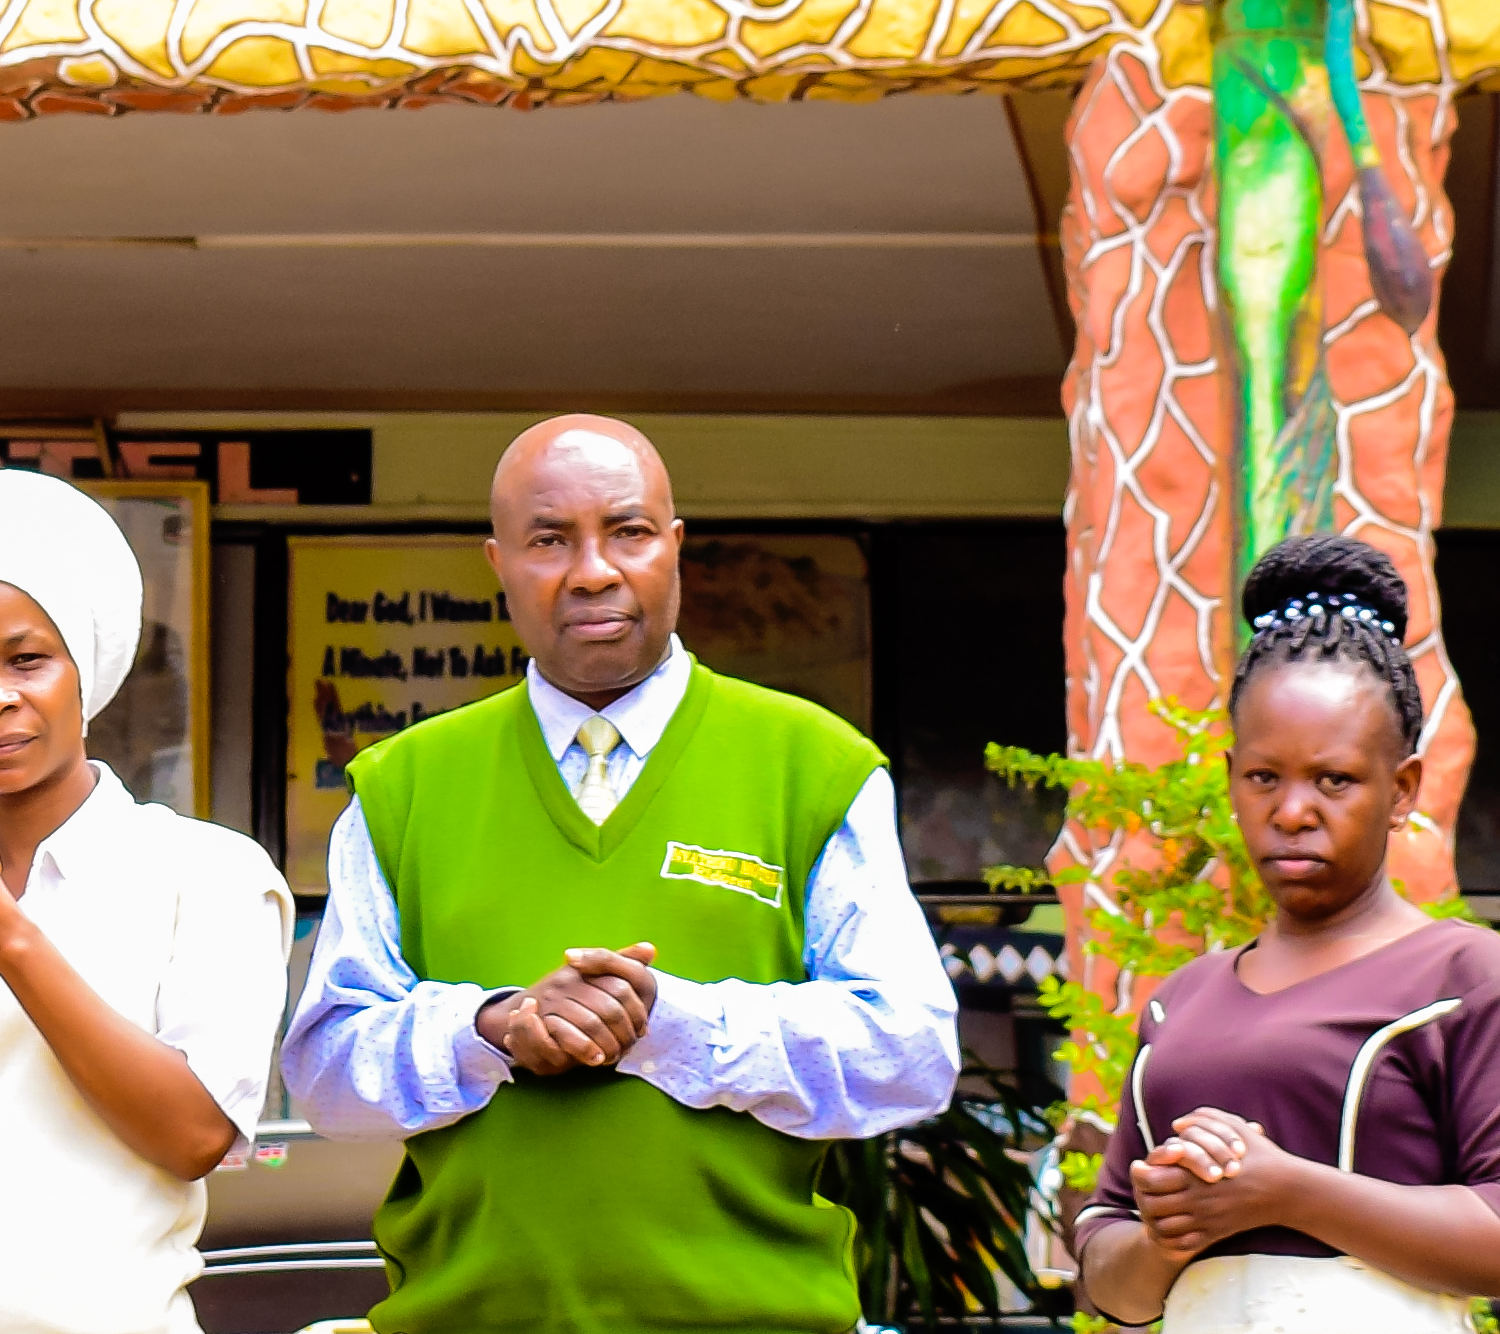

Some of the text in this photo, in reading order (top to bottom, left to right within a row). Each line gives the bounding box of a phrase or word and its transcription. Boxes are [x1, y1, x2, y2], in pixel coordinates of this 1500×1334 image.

[326, 591, 369, 623] Dear
[430, 590, 492, 622] Wanna
[322, 645, 335, 677] A
[413, 646, 445, 677] Not
